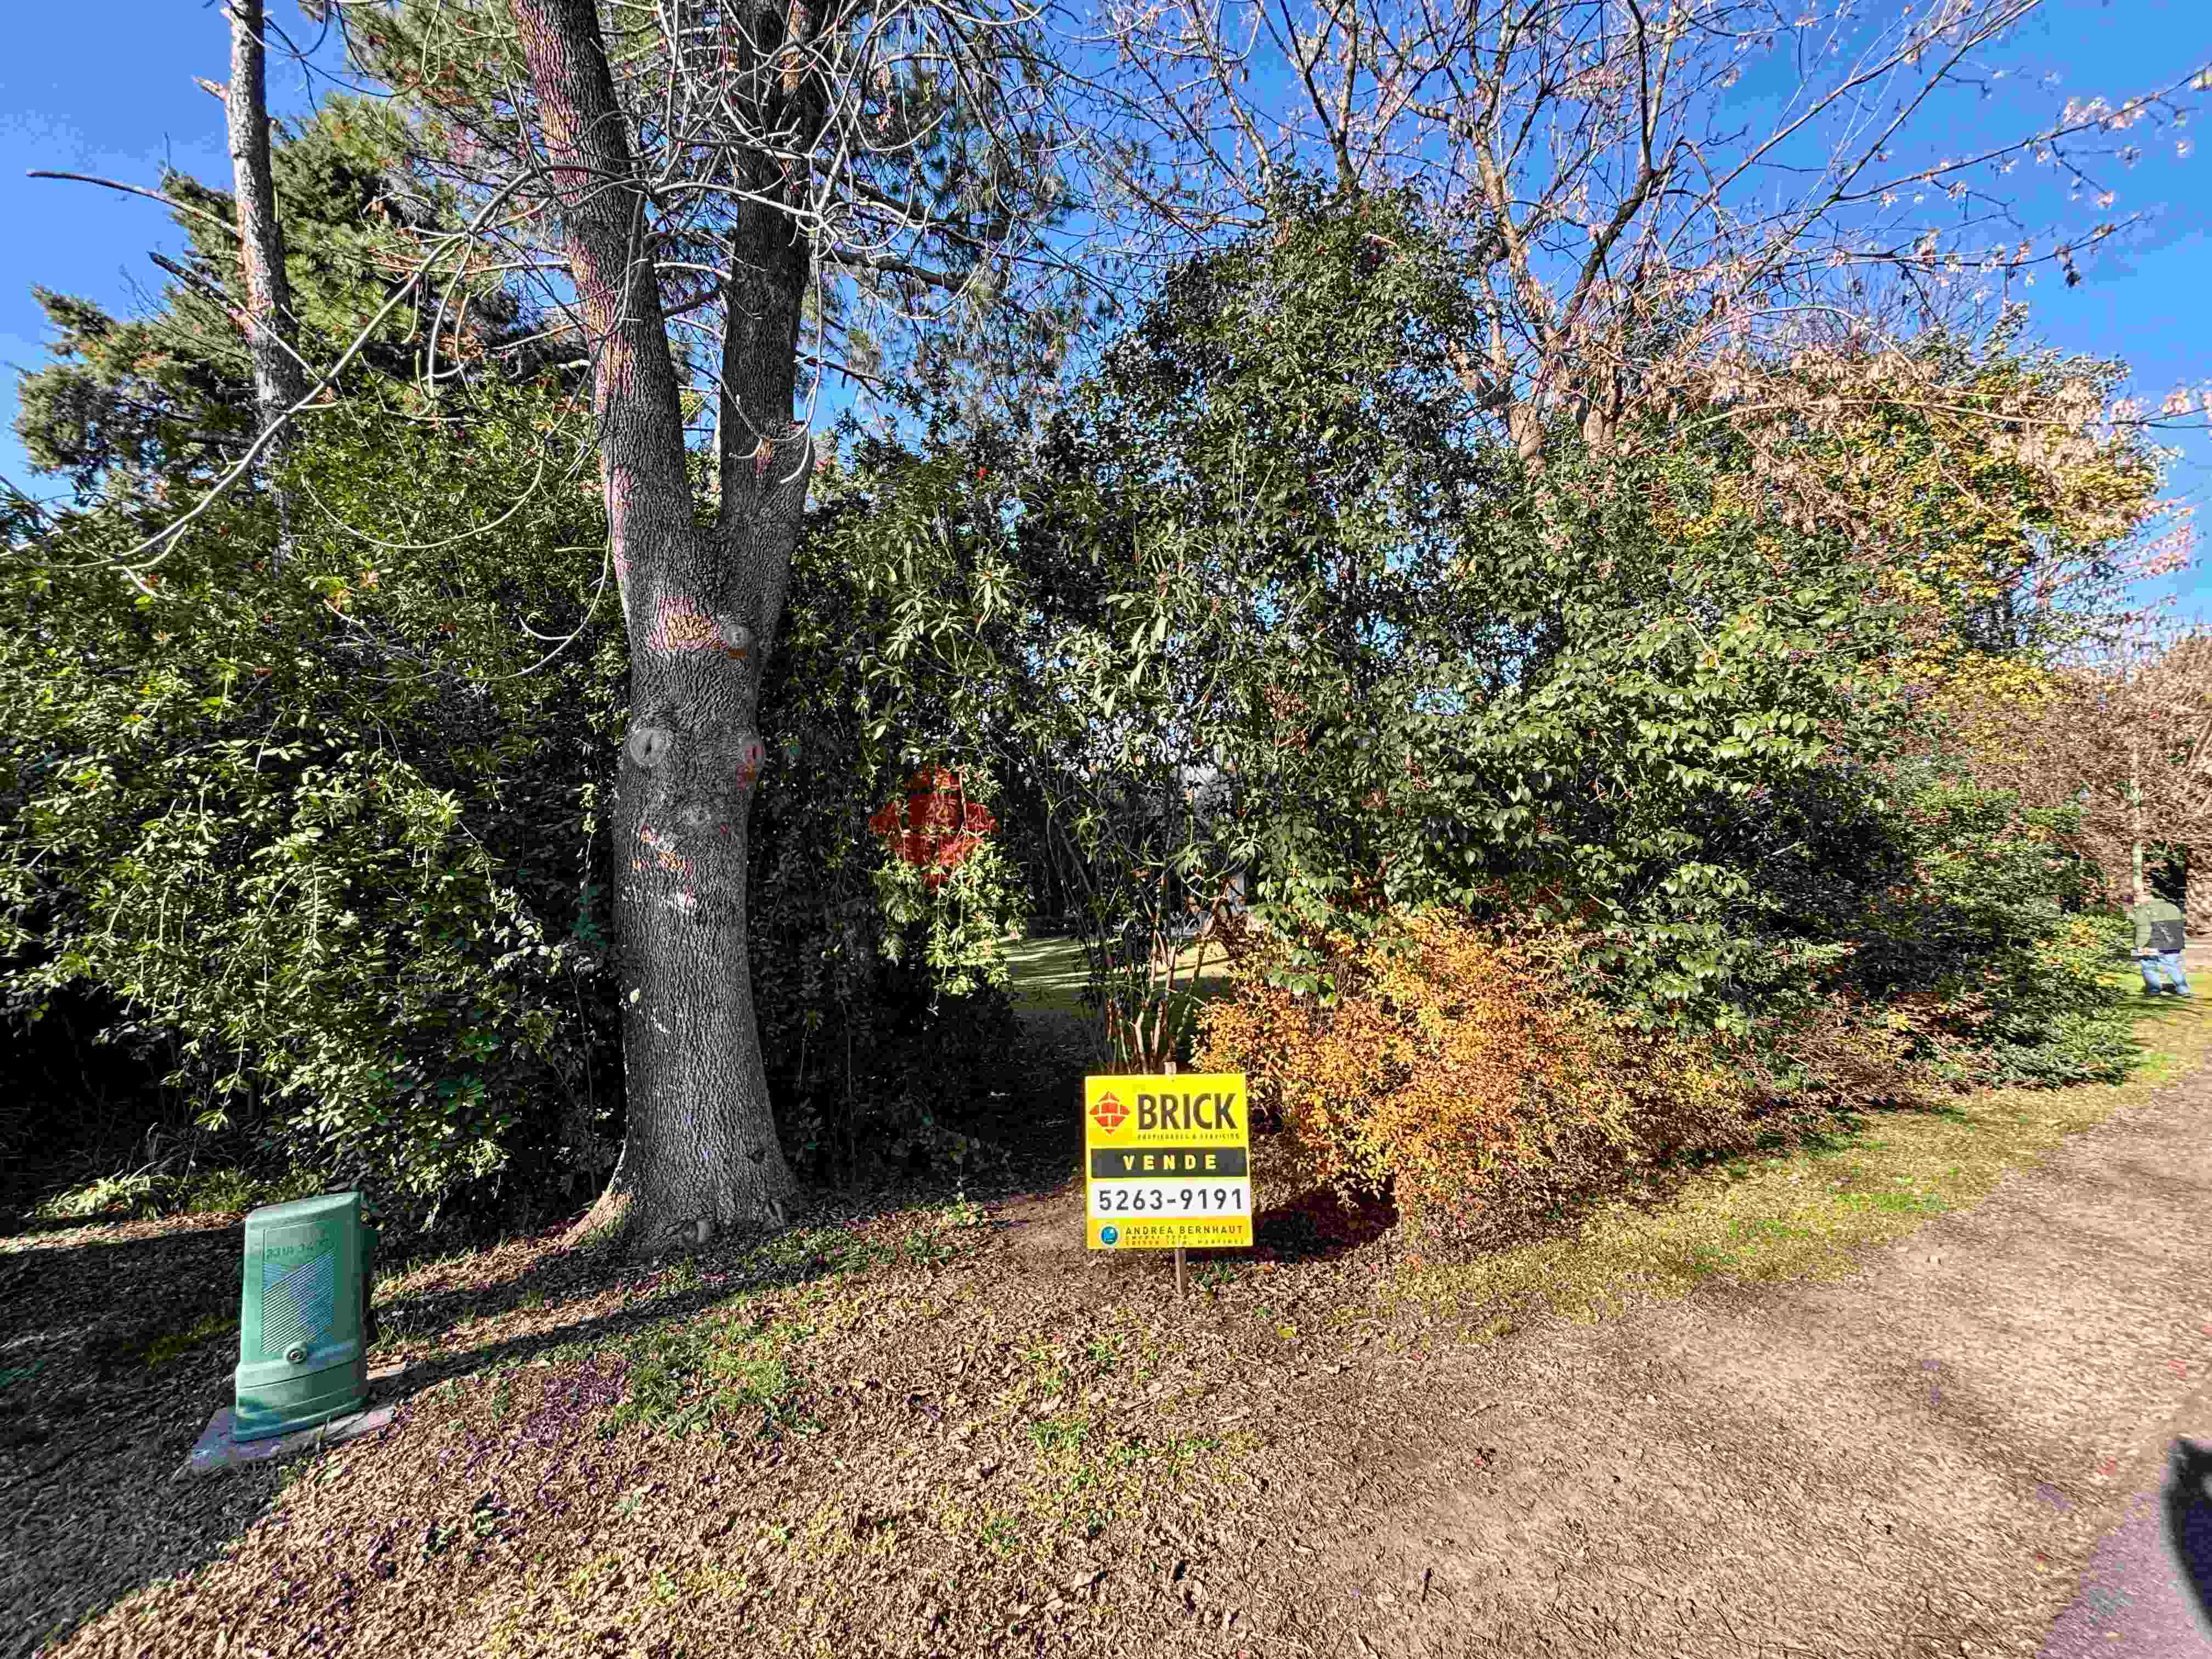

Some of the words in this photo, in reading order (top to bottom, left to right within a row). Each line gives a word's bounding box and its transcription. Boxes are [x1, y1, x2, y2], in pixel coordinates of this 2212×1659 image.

[1138, 1093, 1238, 1130] BRICK
[1124, 1155, 1216, 1170] VENDE
[1099, 1188, 1242, 1210] 5263-9191
[1126, 1226, 1173, 1235] ANDREA
[1180, 1225, 1243, 1234] BERNHAUT
